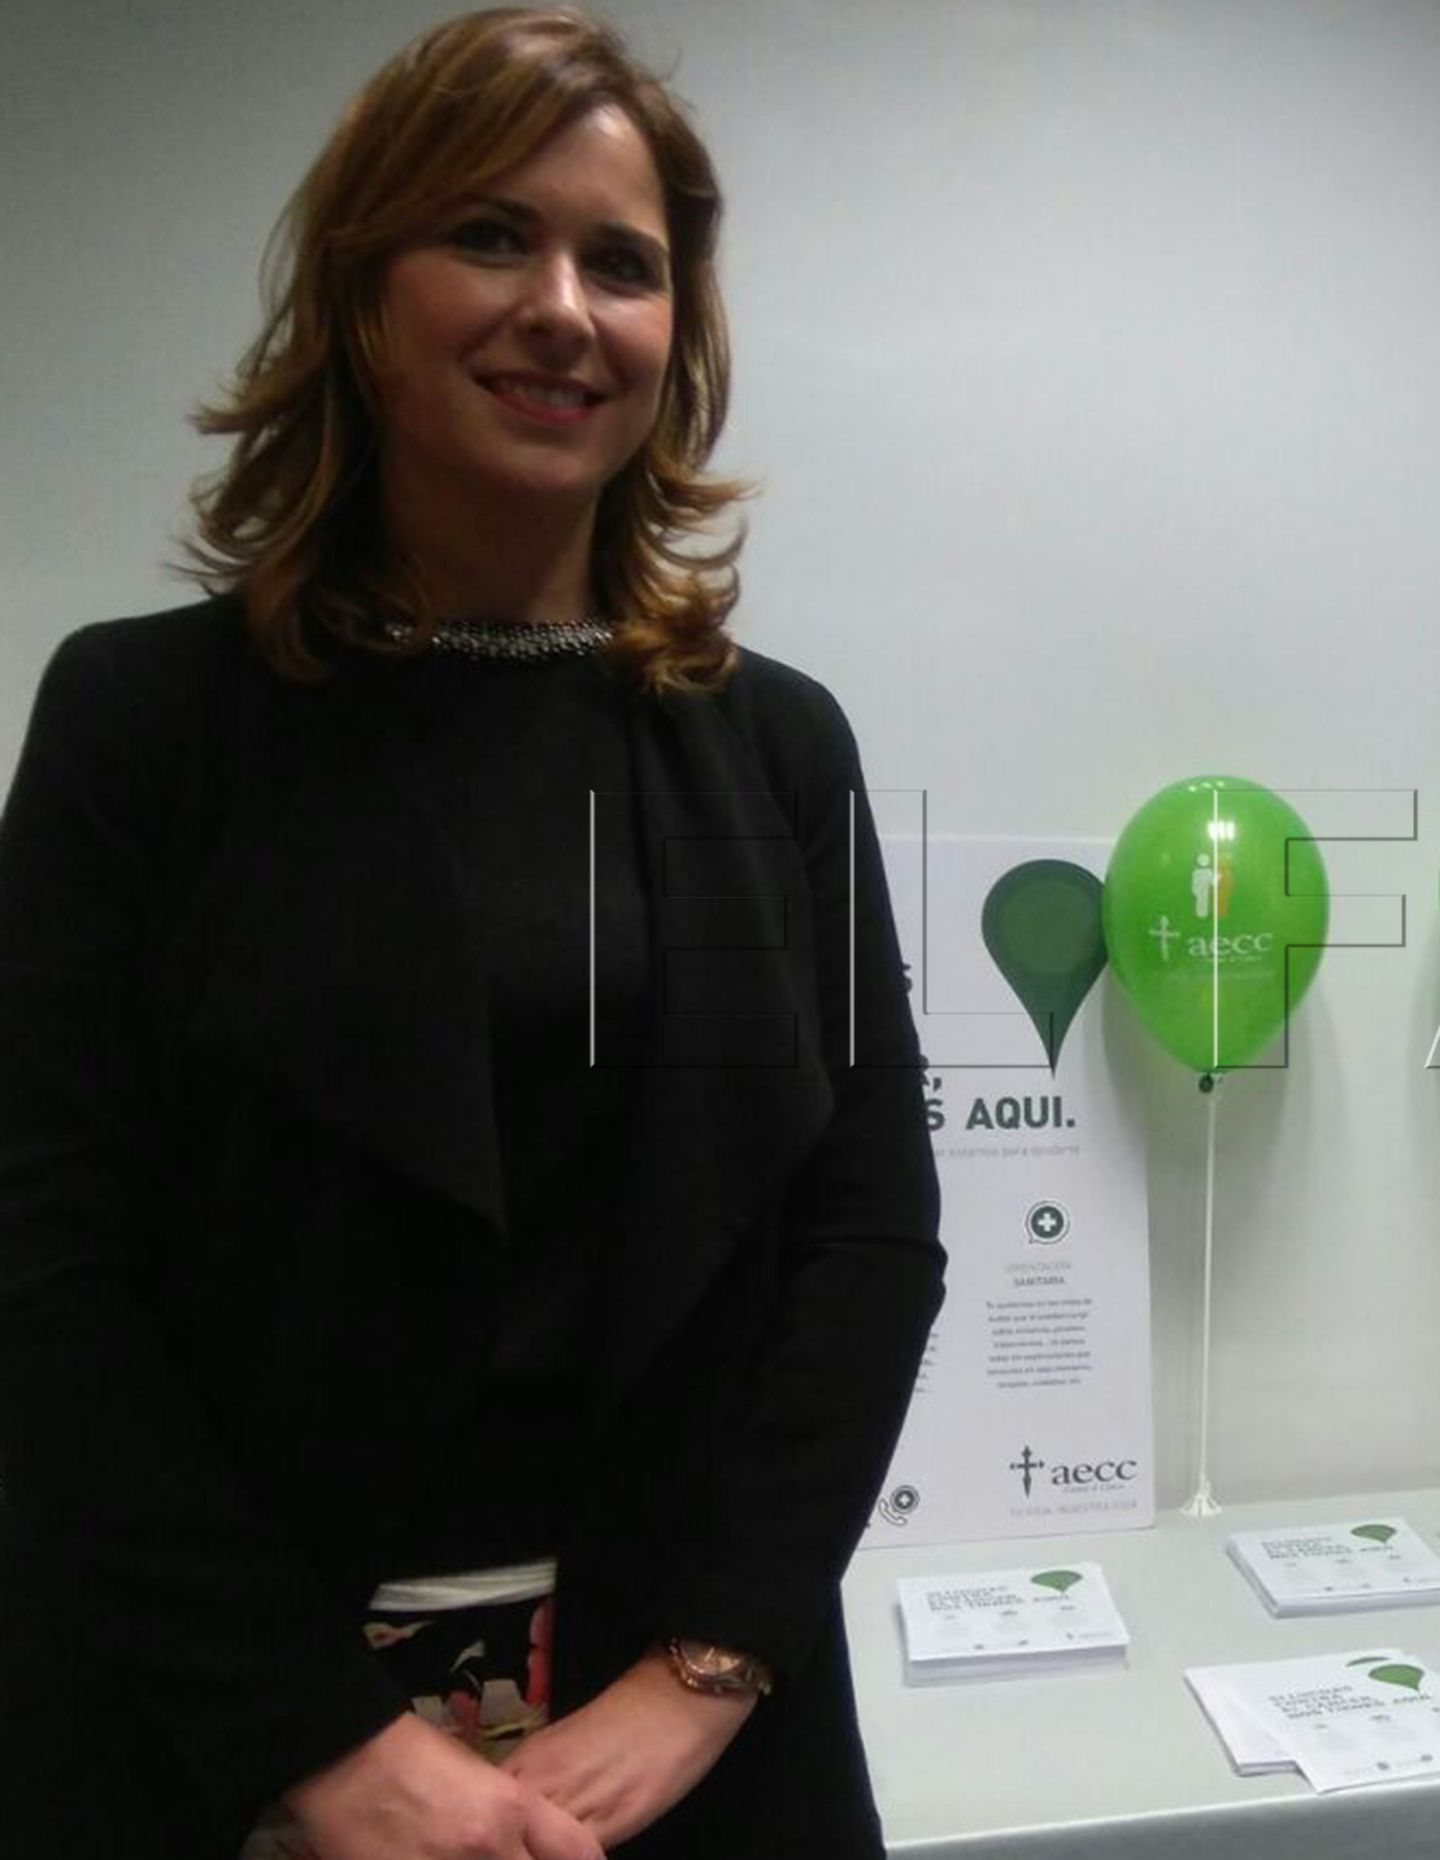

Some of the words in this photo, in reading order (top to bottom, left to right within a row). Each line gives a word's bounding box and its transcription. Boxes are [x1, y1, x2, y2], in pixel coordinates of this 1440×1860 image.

[1187, 932, 1273, 957] aecc
[966, 1096, 1076, 1131] AQUI.
[1051, 1460, 1138, 1485] aecc
